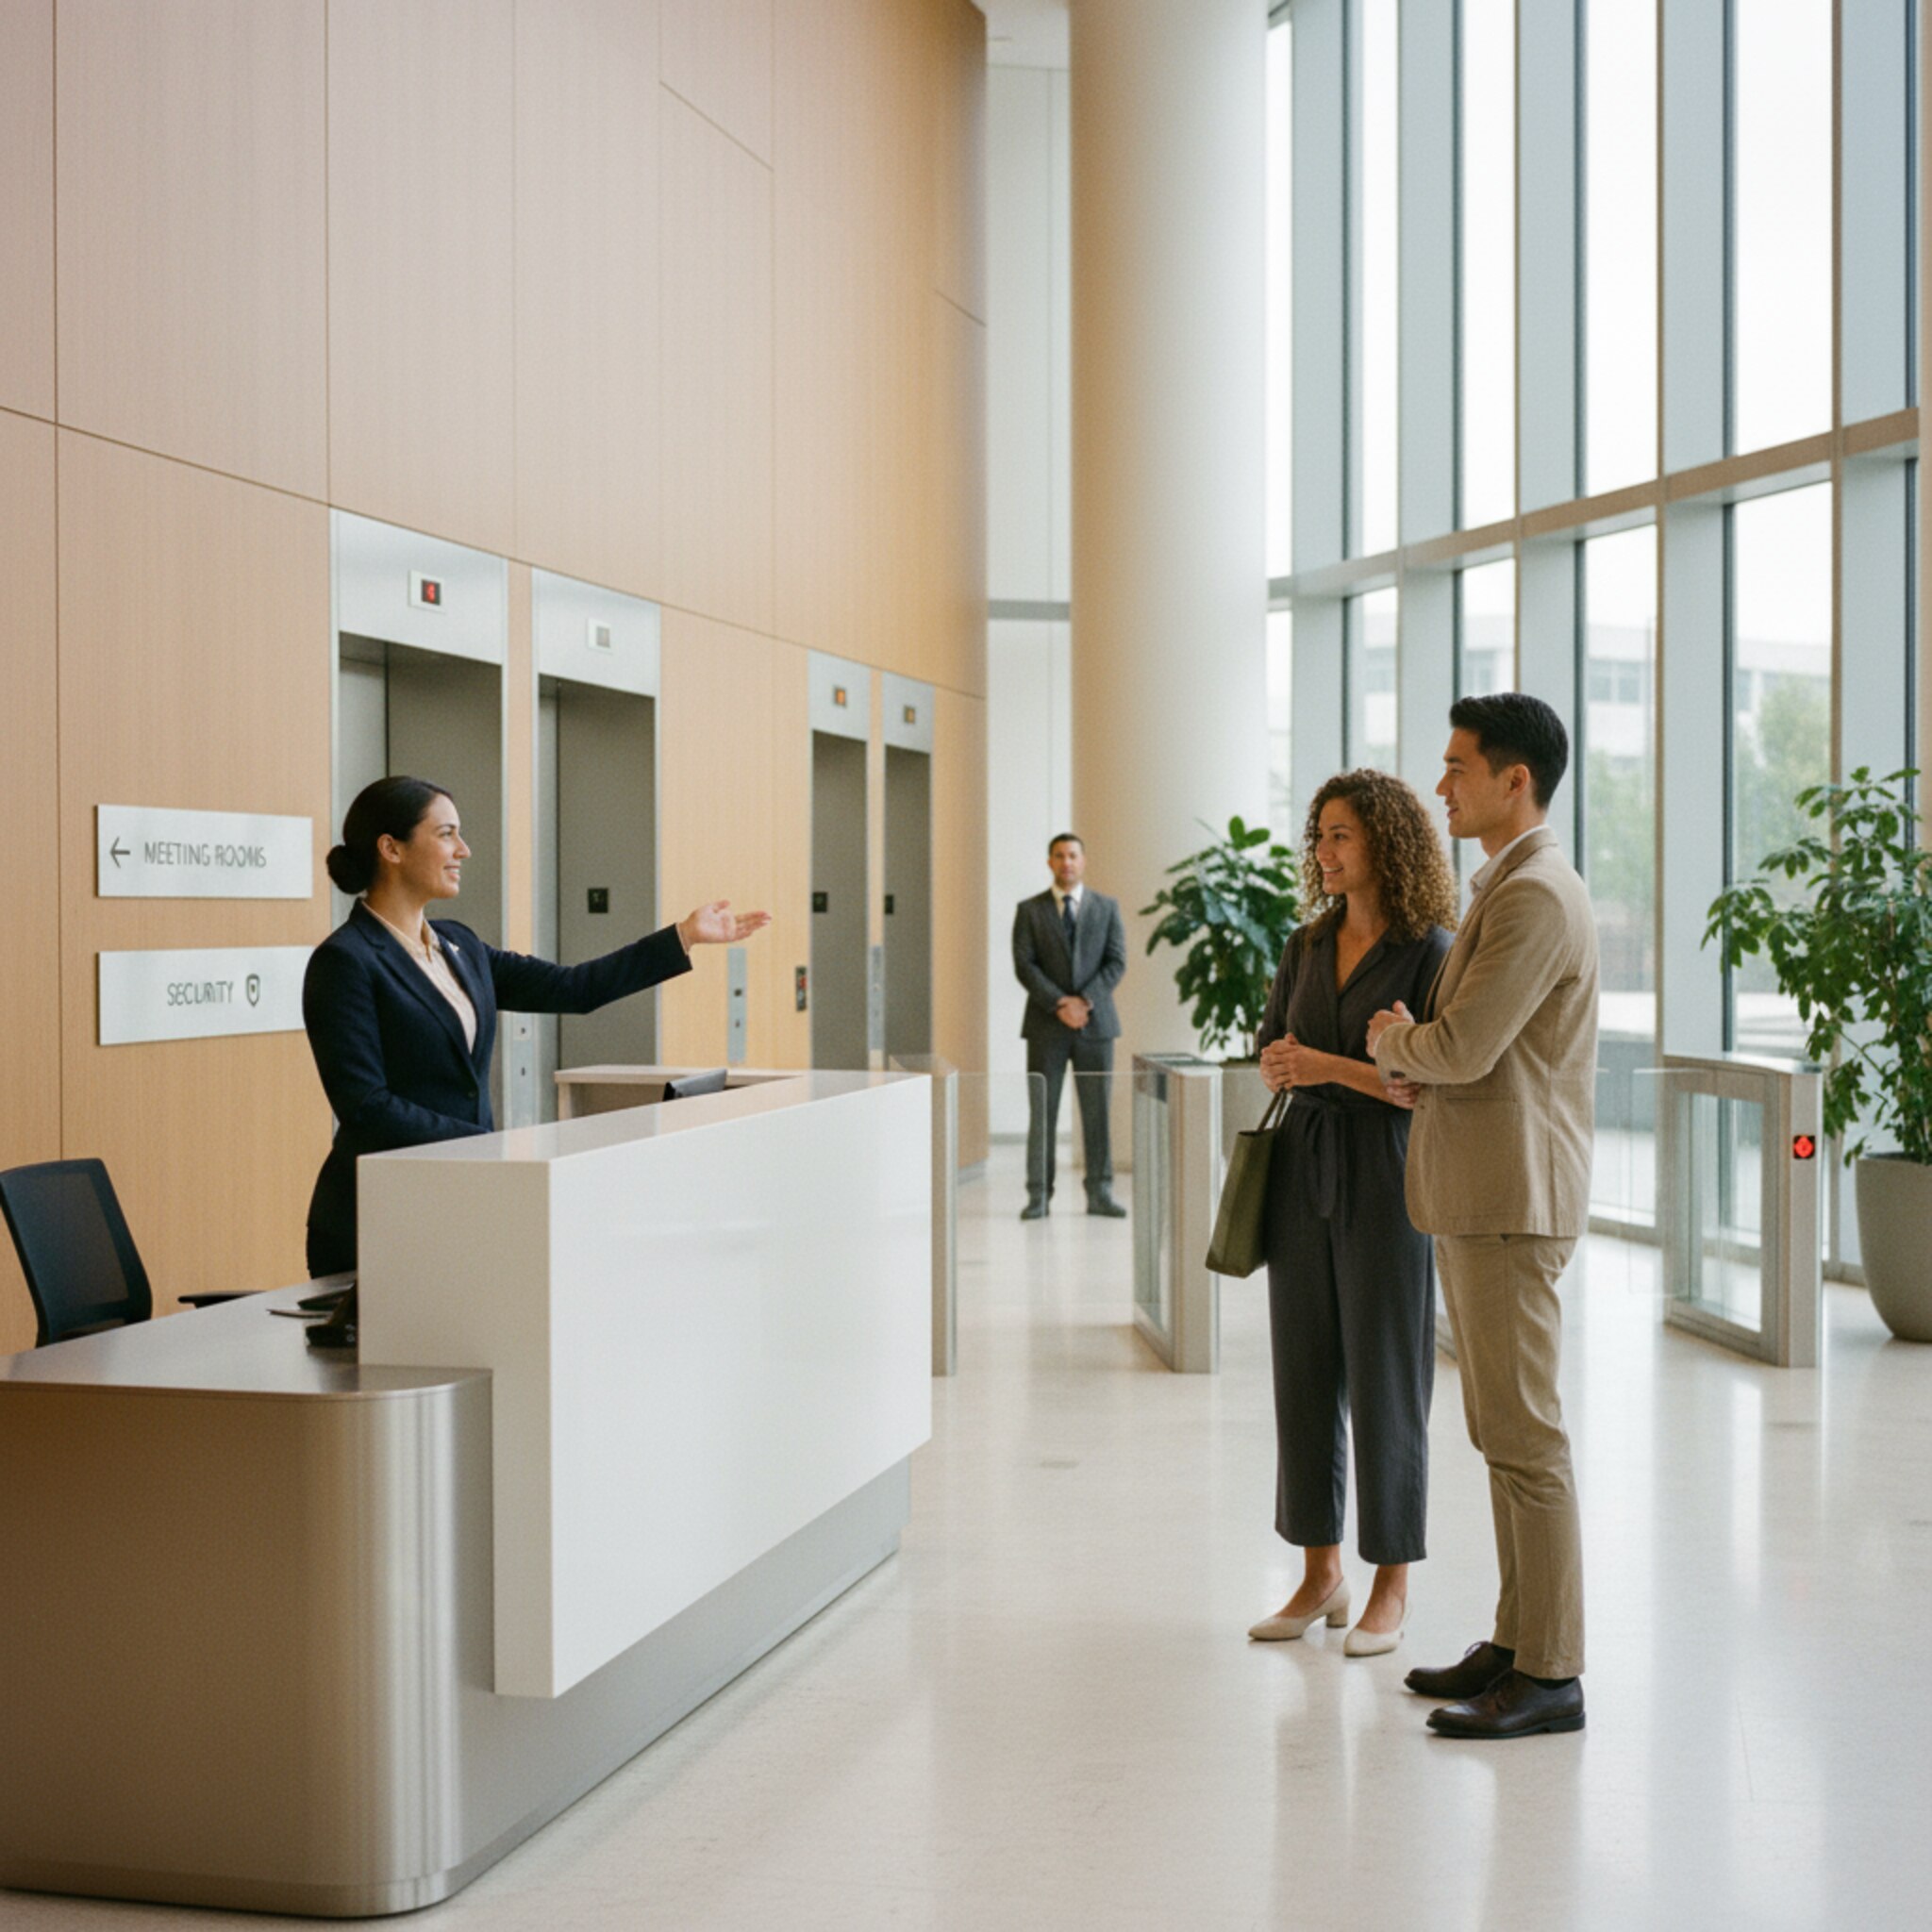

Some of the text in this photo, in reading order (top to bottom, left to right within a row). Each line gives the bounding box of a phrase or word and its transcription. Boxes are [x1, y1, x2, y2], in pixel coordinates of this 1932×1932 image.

[144, 841, 267, 868] MEETING ROOMS
[167, 980, 234, 1007] SECURITY
